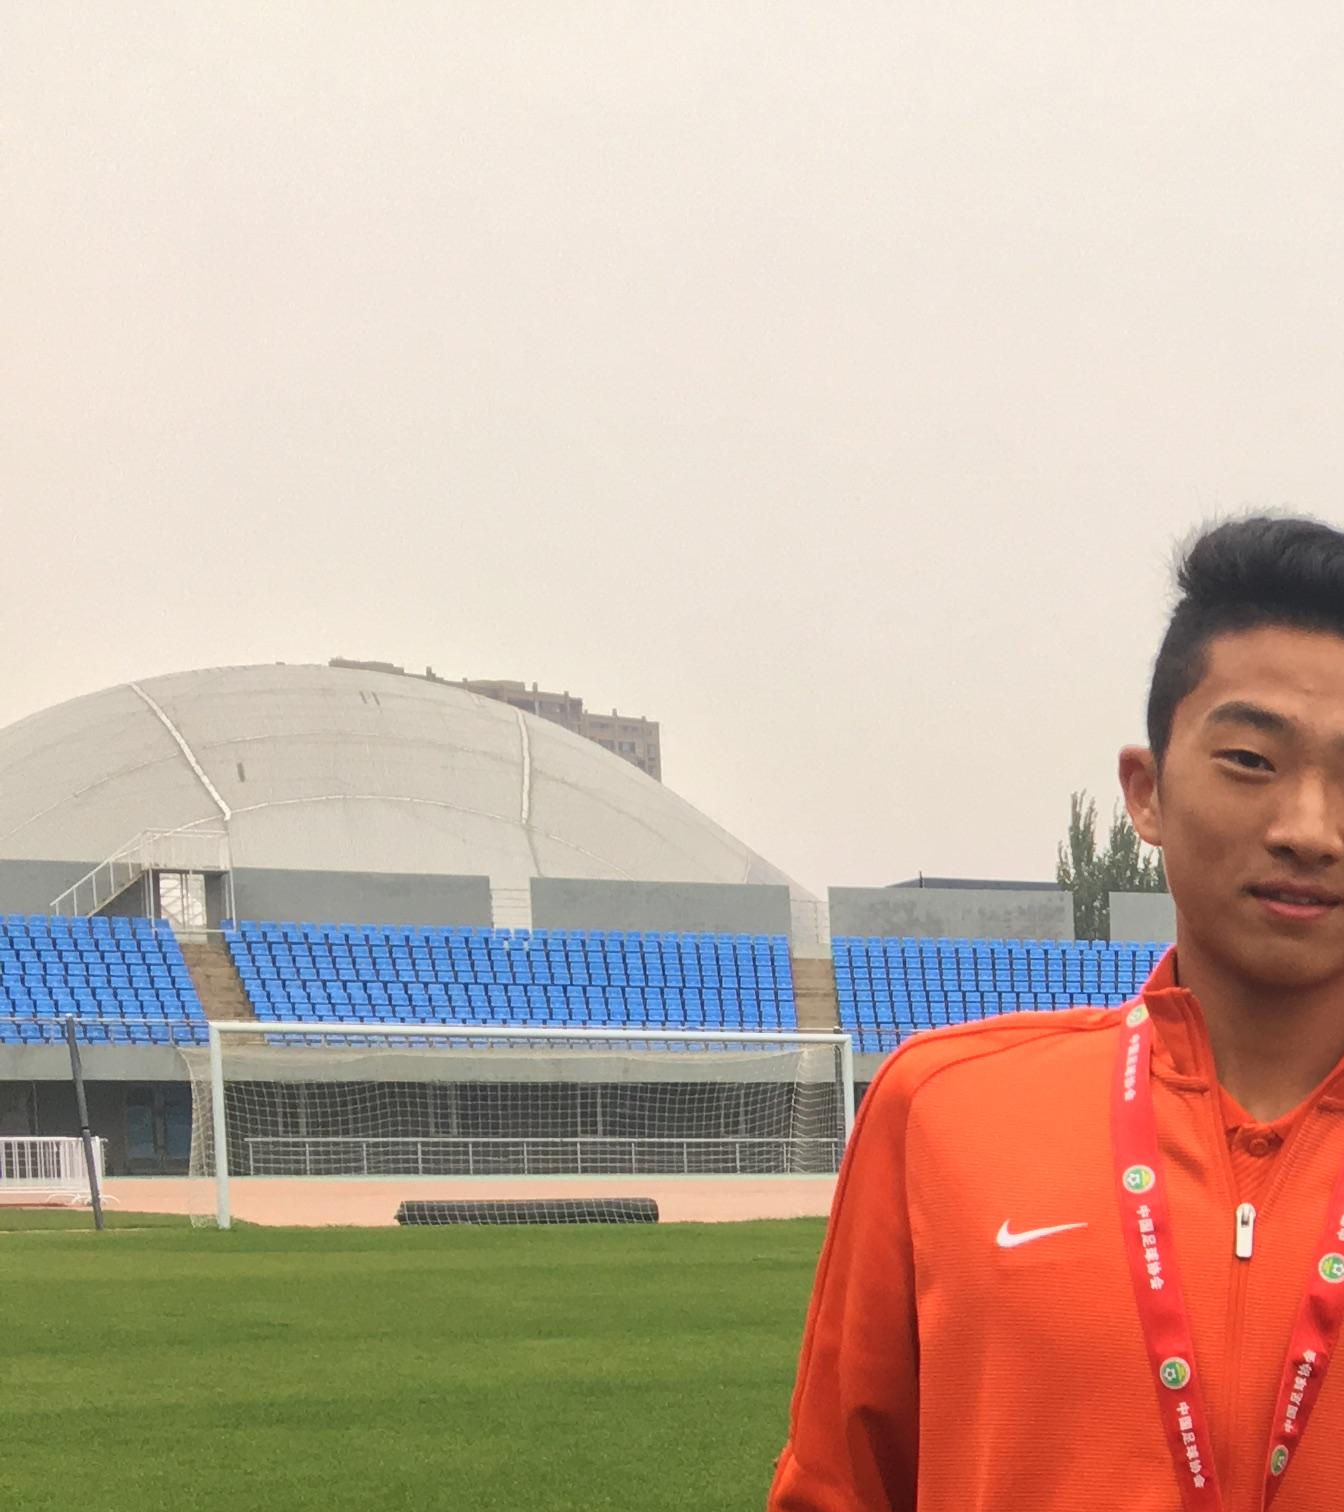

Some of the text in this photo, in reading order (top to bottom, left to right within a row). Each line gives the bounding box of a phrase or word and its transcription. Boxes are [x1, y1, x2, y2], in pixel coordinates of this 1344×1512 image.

[1136, 1205, 1165, 1291] 中国足球协会
[1283, 1349, 1317, 1433] 中国足球协会
[1175, 1401, 1206, 1489] 中国足球协会
